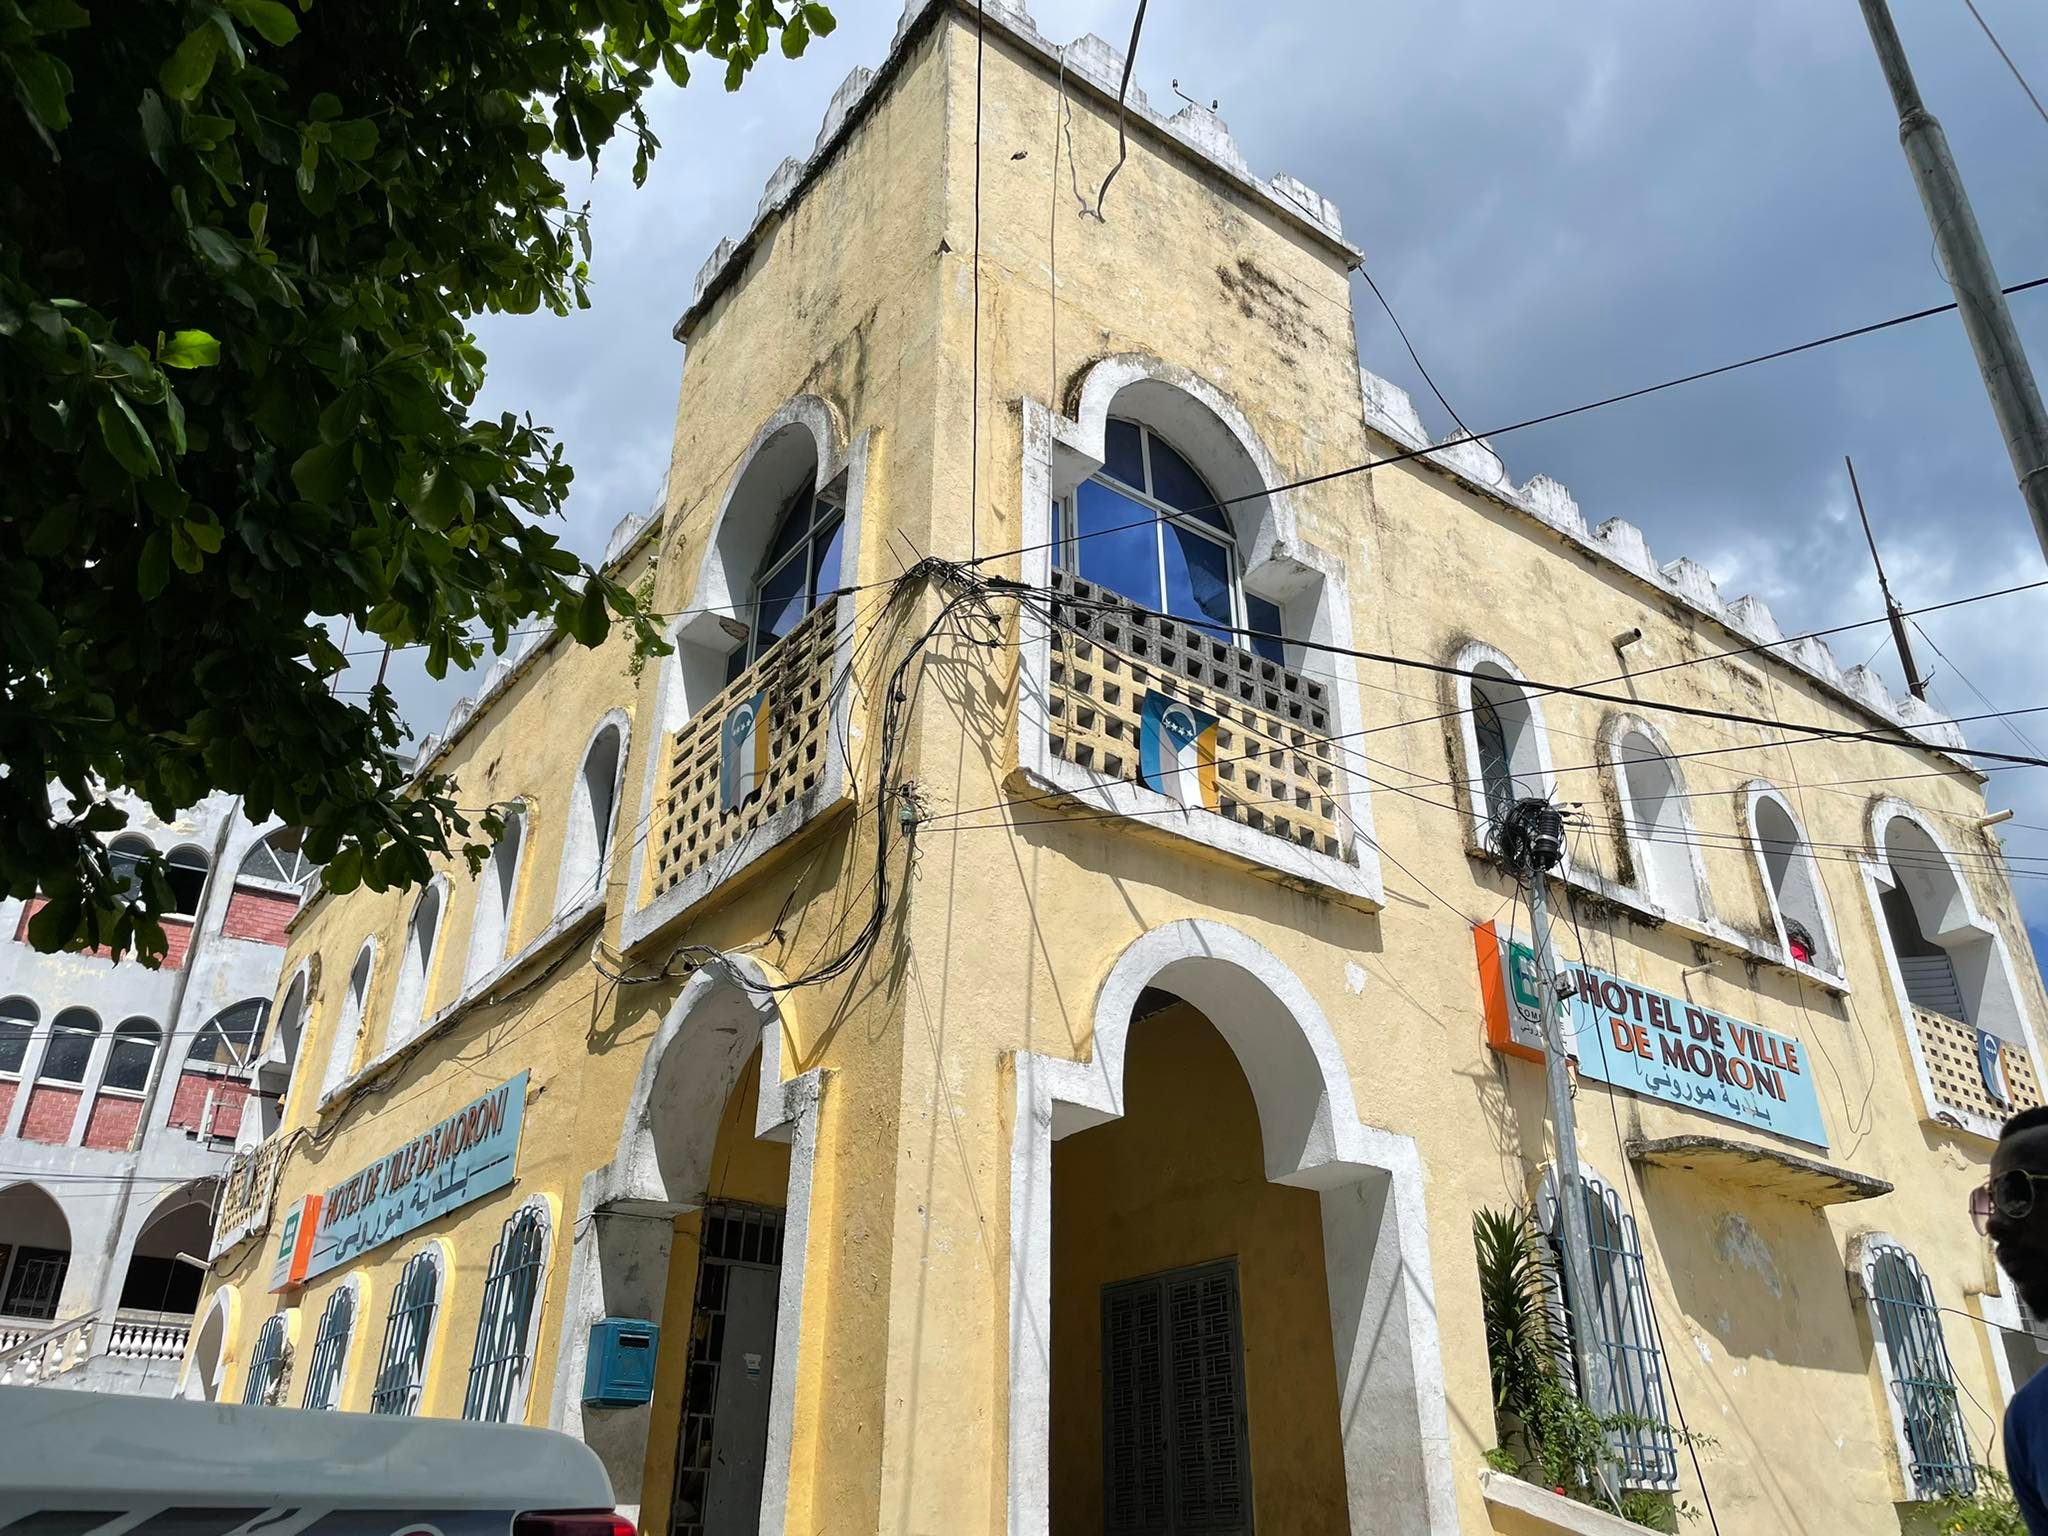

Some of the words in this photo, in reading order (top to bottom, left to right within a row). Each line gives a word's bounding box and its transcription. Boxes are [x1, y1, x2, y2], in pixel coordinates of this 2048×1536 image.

[1576, 968, 1682, 1034] HOTEL
[1685, 1006, 1724, 1050] DE
[1726, 1021, 1800, 1075] VILLE
[1609, 1015, 1653, 1061] DE
[1658, 1032, 1787, 1103] MORONI
[323, 1173, 364, 1231] HOTEL
[361, 1162, 384, 1209] DE
[381, 1140, 420, 1199] VILLE
[416, 1128, 441, 1180] DE
[436, 1086, 509, 1168] MORONI
